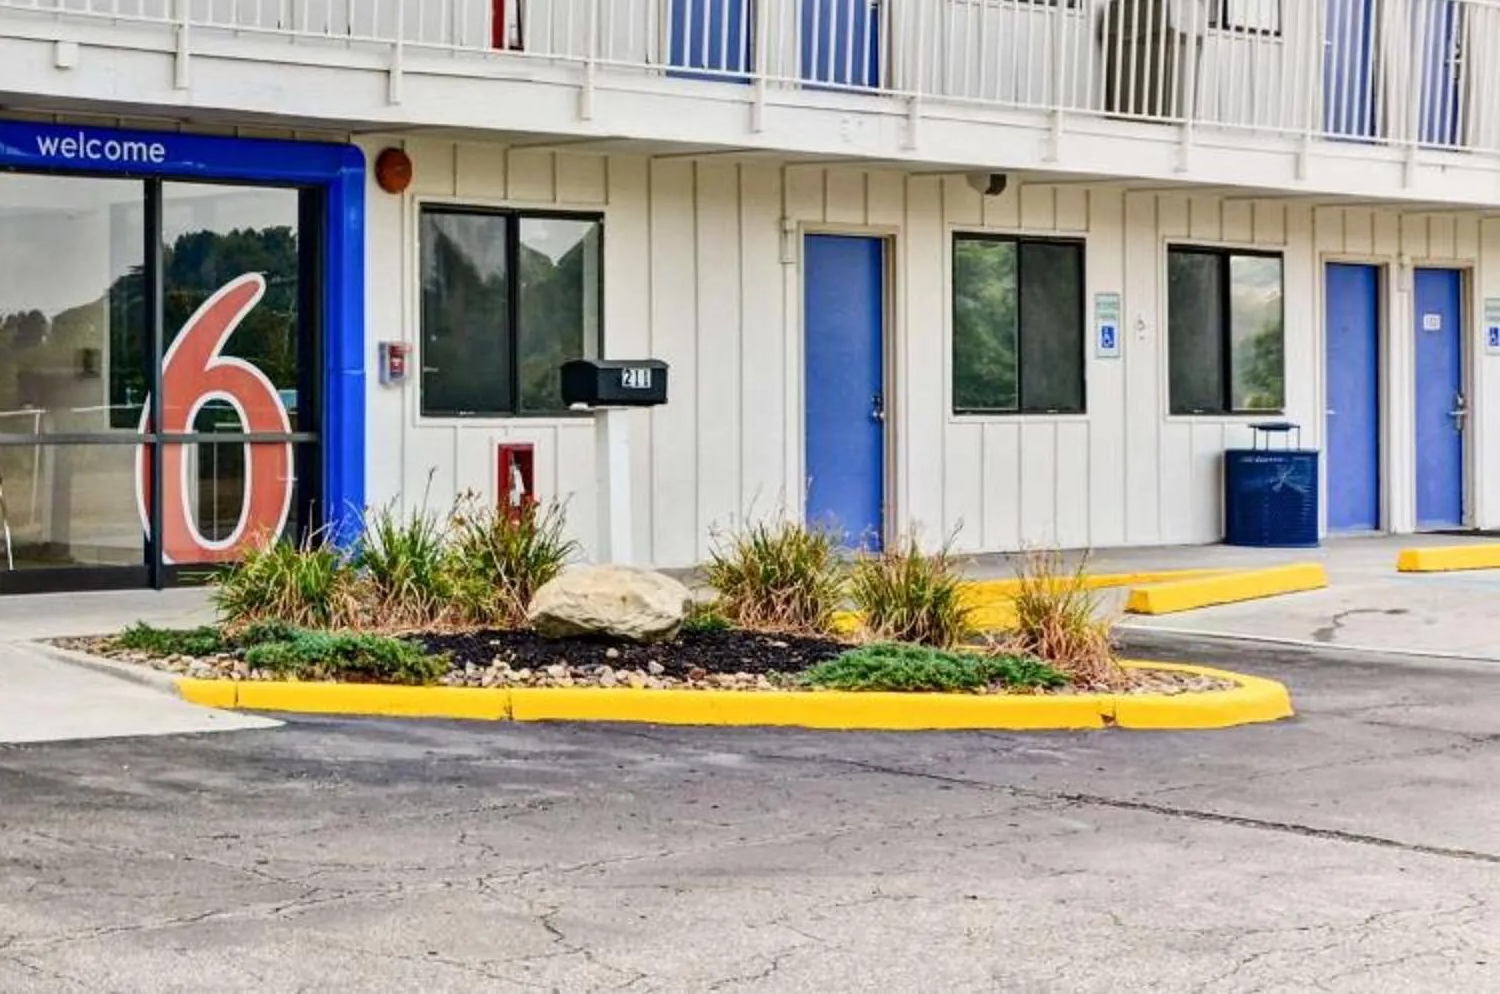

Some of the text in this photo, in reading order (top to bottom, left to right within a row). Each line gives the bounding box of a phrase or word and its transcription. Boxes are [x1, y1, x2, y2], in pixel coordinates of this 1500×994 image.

[36, 131, 165, 163] welcome
[622, 367, 649, 388] 211
[135, 271, 294, 565] 6
